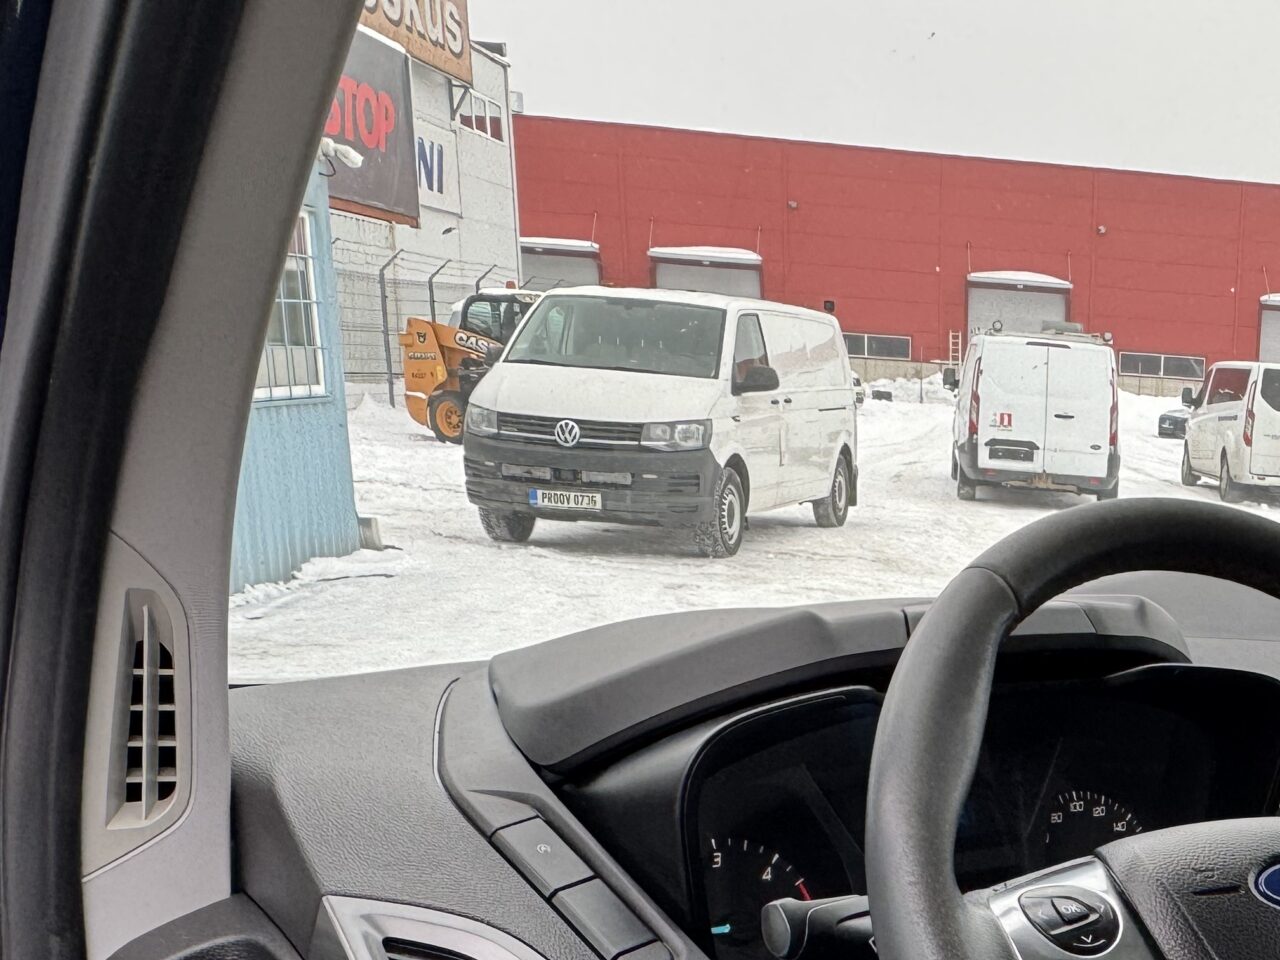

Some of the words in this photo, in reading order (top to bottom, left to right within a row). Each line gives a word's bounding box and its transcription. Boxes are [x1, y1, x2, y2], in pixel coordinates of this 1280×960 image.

[711, 852, 722, 868] 3
[761, 866, 773, 881] 4
[1061, 903, 1083, 914] OK
